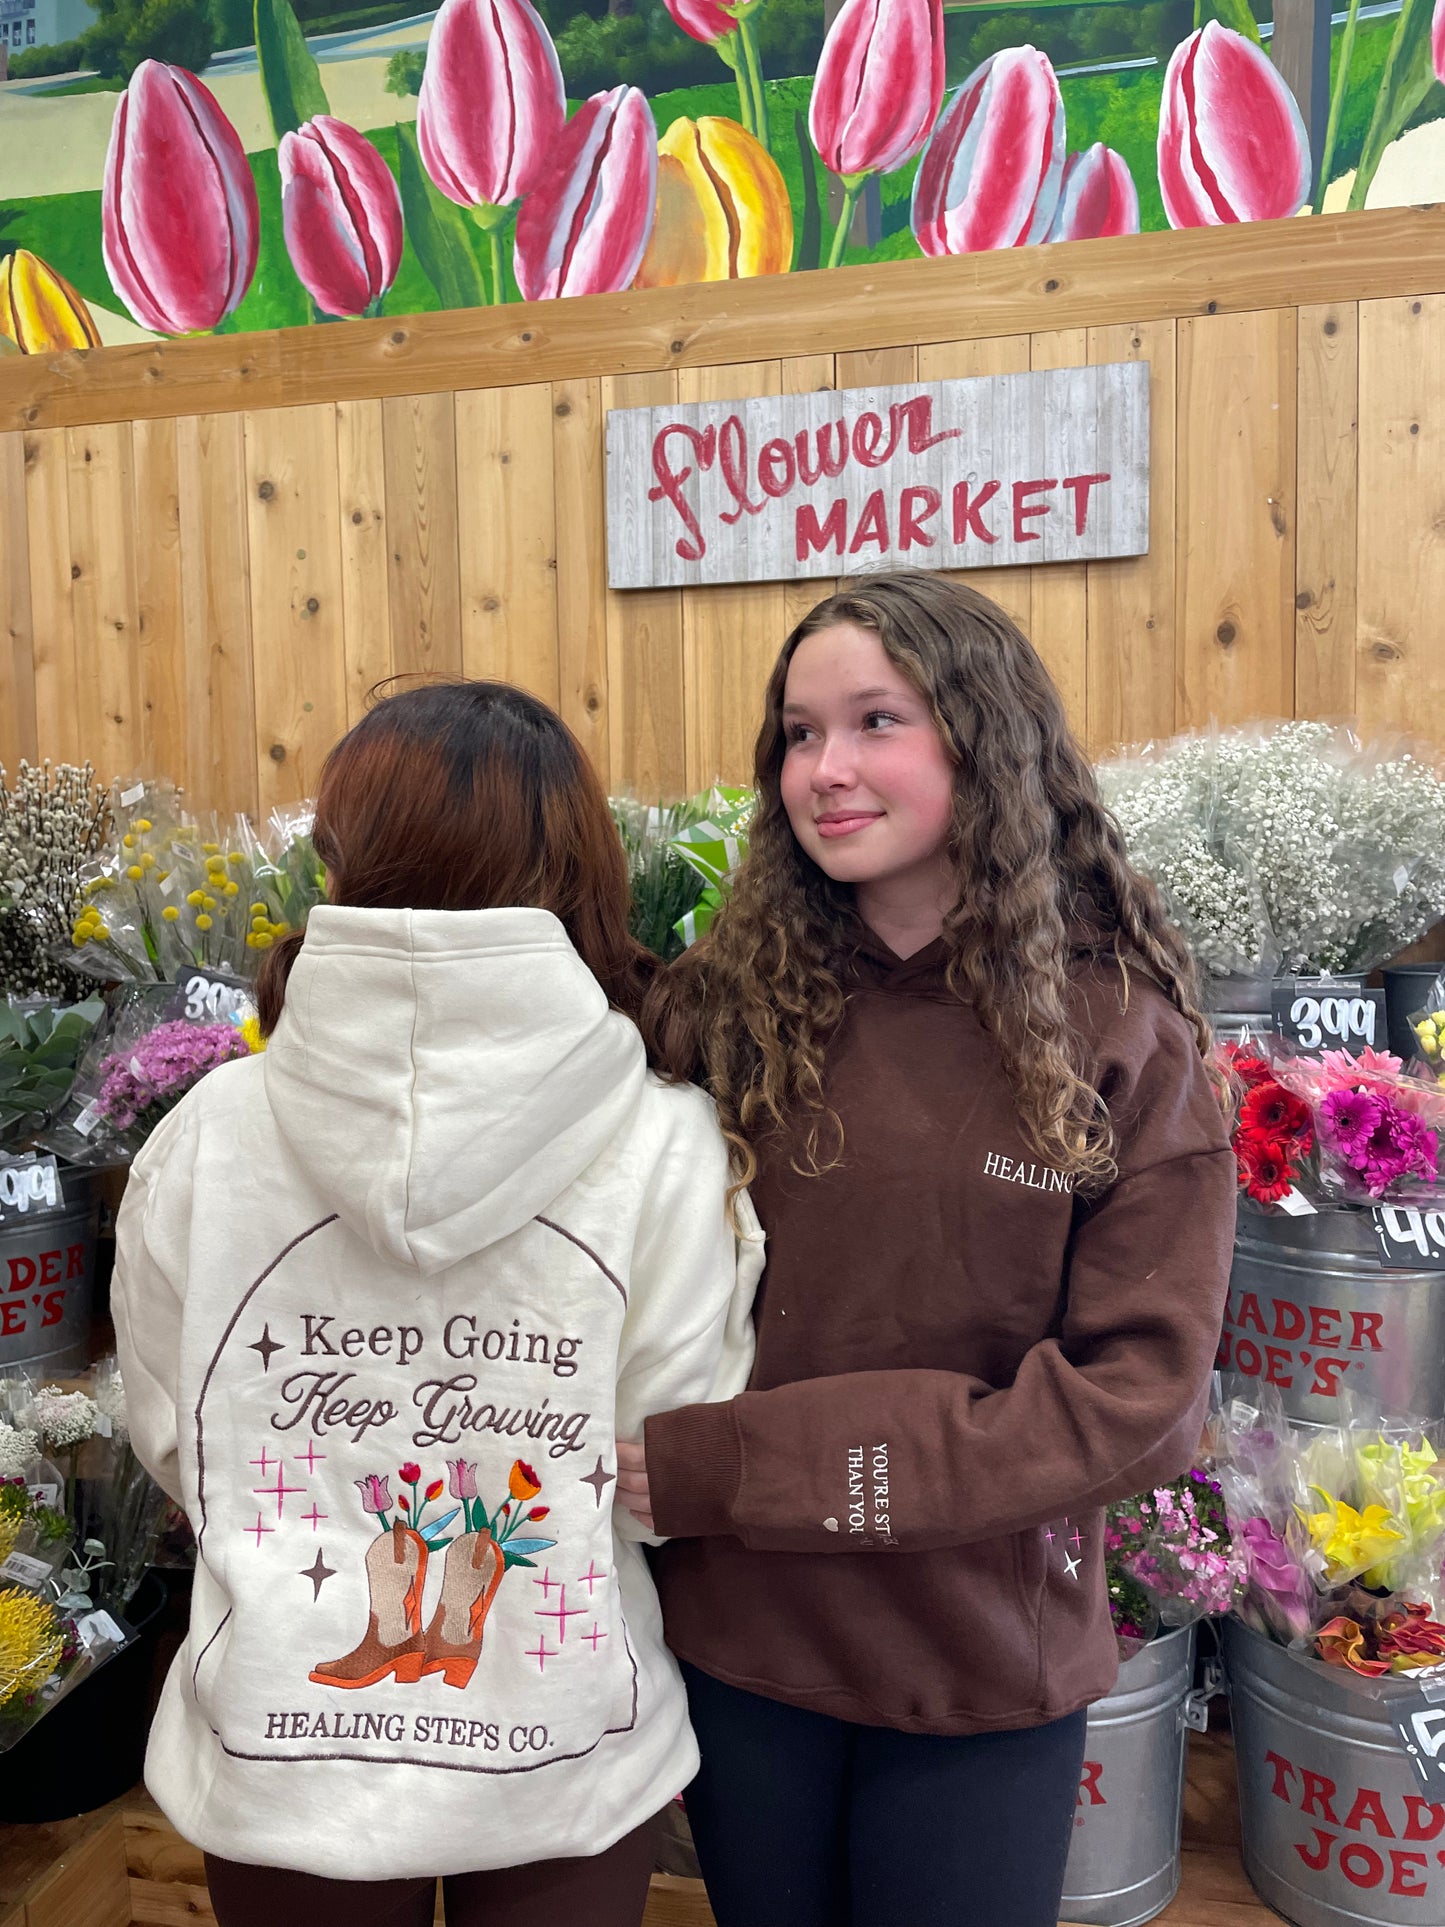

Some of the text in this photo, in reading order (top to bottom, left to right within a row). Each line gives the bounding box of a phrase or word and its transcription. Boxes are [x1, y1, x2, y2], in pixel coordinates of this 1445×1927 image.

[796, 473, 1111, 562] MARKET
[0, 1242, 86, 1294] DER
[299, 1315, 583, 1377] Keep Going
[270, 1371, 591, 1458] Keep Growing
[872, 1443, 889, 1510] YOU'RE
[264, 1712, 554, 1752] HEALING STEPS CO.
